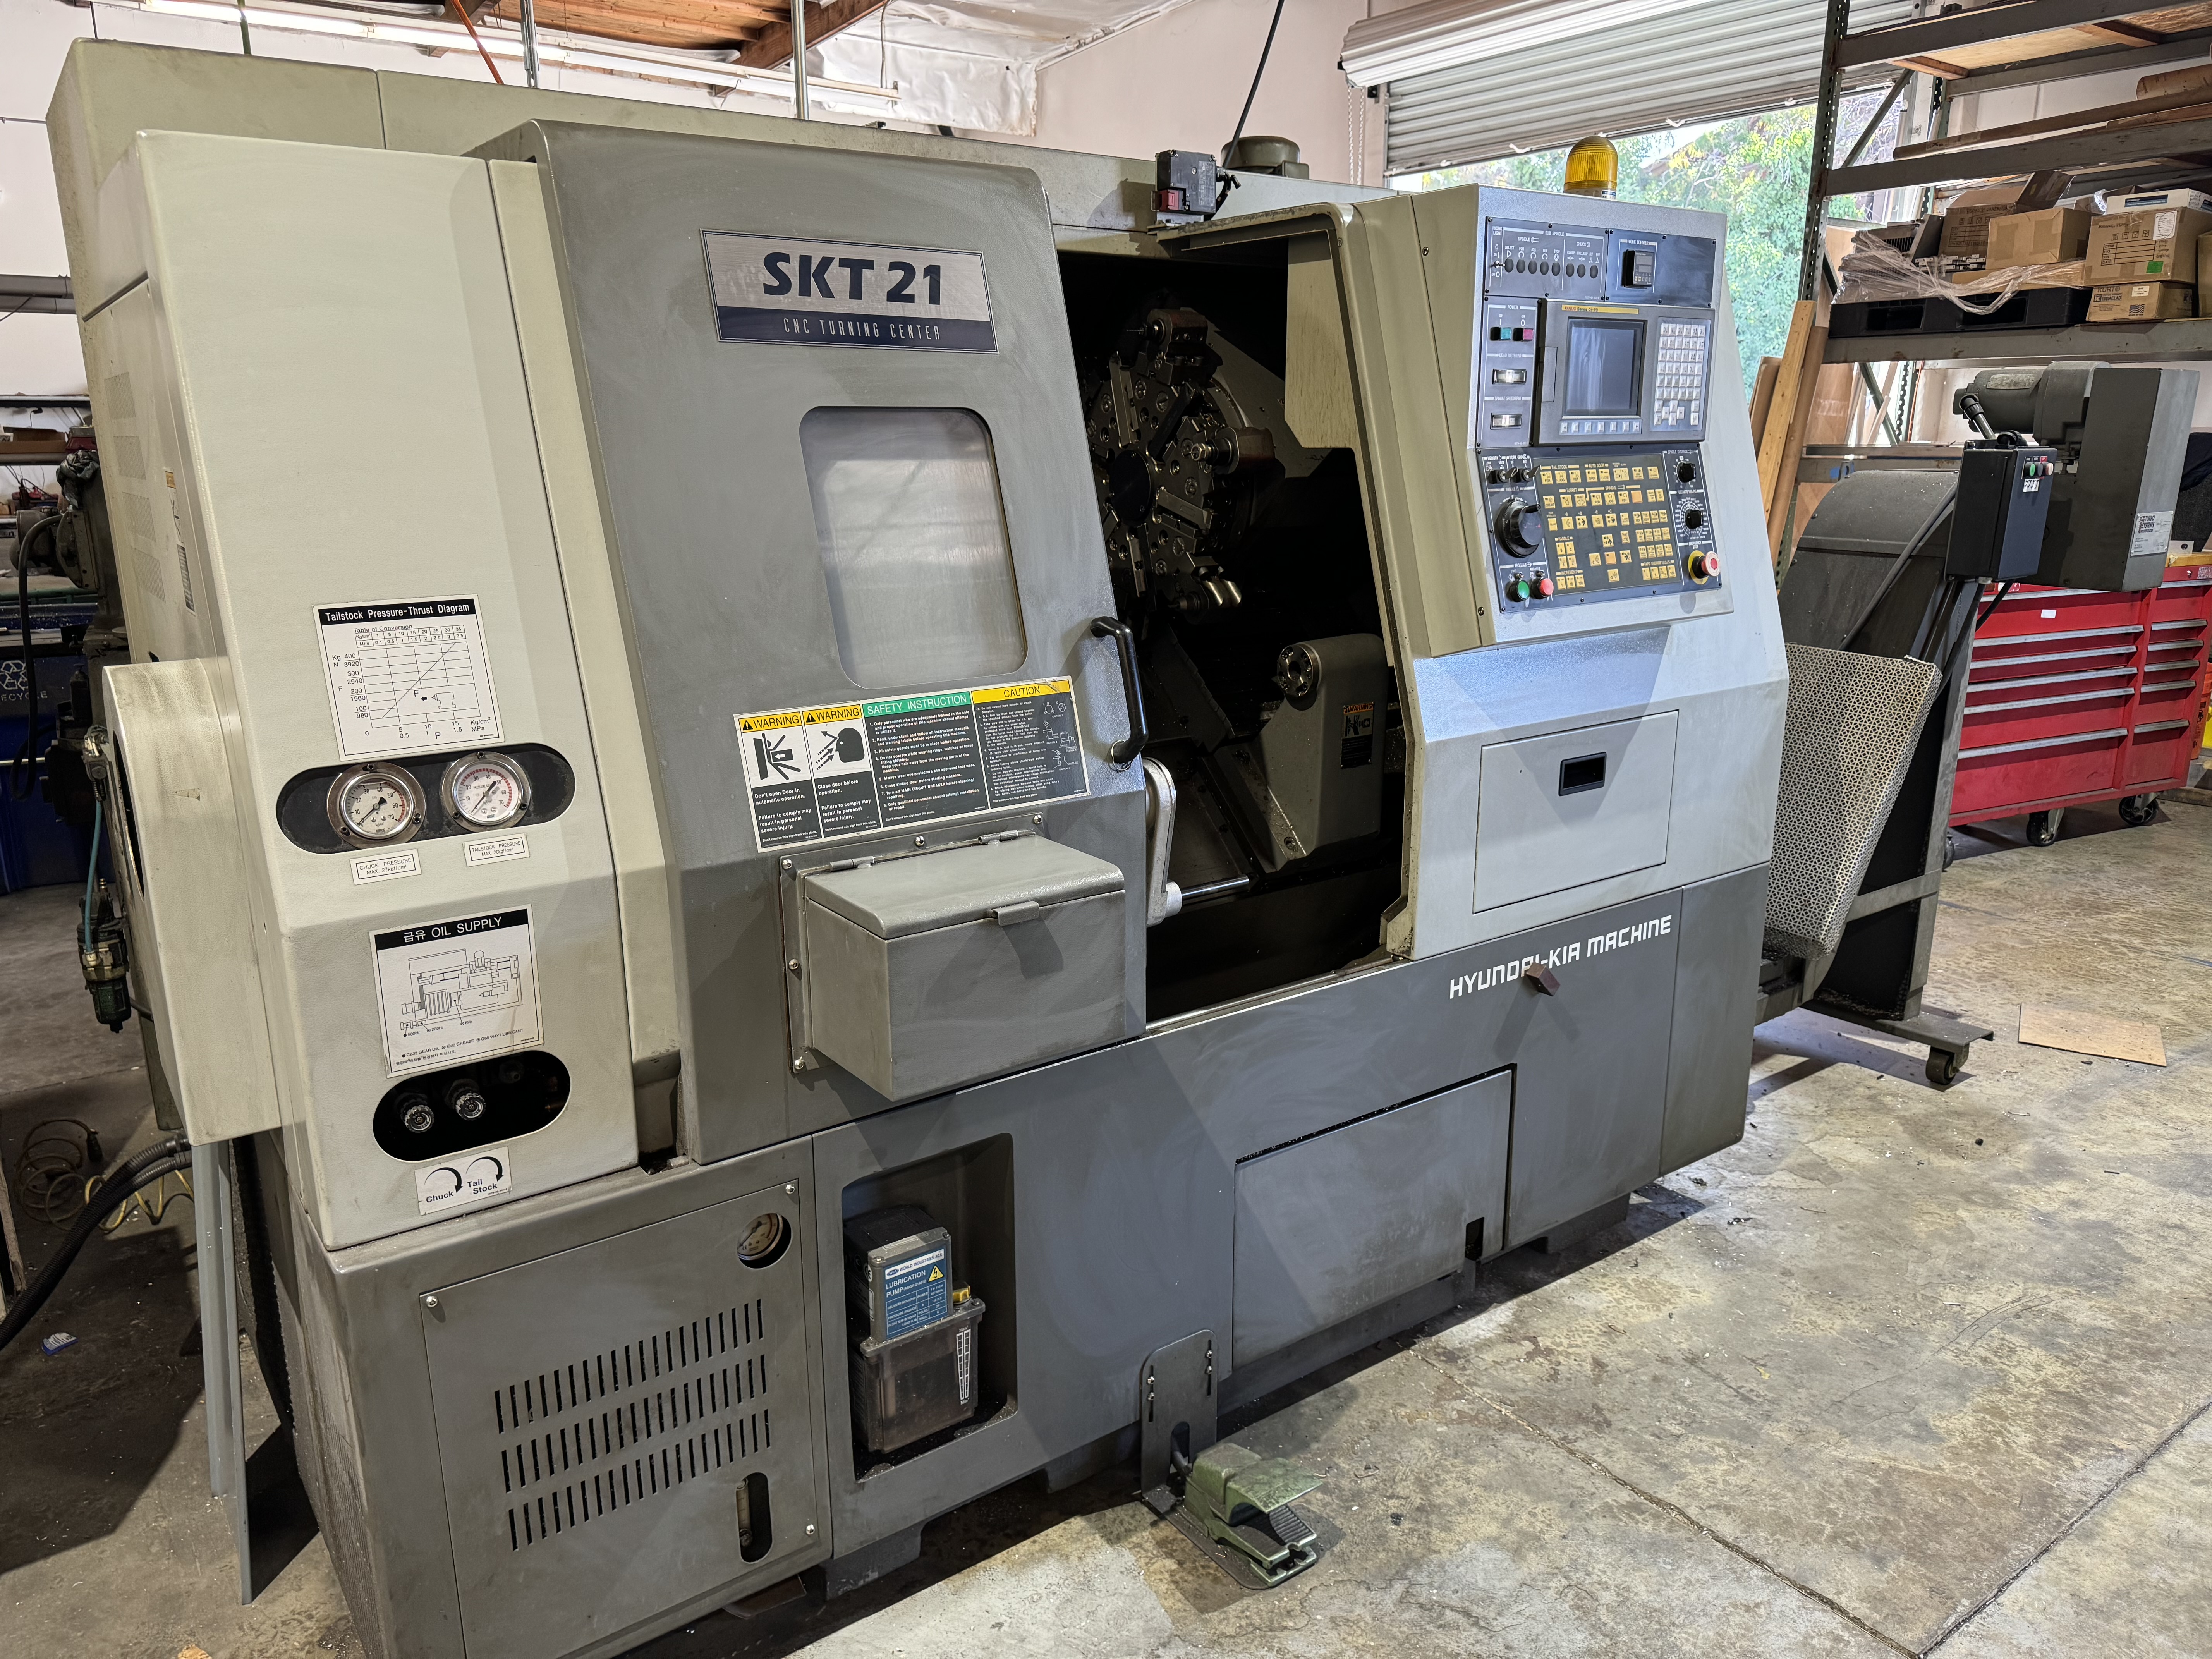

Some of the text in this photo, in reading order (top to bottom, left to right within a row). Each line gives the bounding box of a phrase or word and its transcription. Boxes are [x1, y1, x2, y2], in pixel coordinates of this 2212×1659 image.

[763, 252, 941, 305] SKT 21
[784, 318, 941, 340] CNC TURNING CENTER
[325, 604, 470, 622] Tailstock Pressure-Thrust Diagram
[0, 692, 47, 701] ECYCE
[1004, 686, 1040, 697] CAUTION
[867, 694, 967, 714] SAFETY INSTRUCTION
[1349, 704, 1372, 712] WARNING
[816, 708, 859, 721] WARNING
[753, 716, 799, 728] WARNING
[843, 806, 862, 815] personal
[384, 858, 412, 866] PRESSURE
[404, 917, 501, 943] 급유 OIL SUPPLY
[1587, 915, 1672, 957] MACHINE
[500, 1028, 524, 1037] LUBRICANT
[467, 1179, 483, 1188] Tail
[473, 1183, 498, 1194] Stock
[426, 1191, 453, 1203] Chuck
[914, 1256, 934, 1266] INDUSTRIES
[886, 1270, 926, 1290] LUBRICATION
[886, 1287, 903, 1298] PUMP
